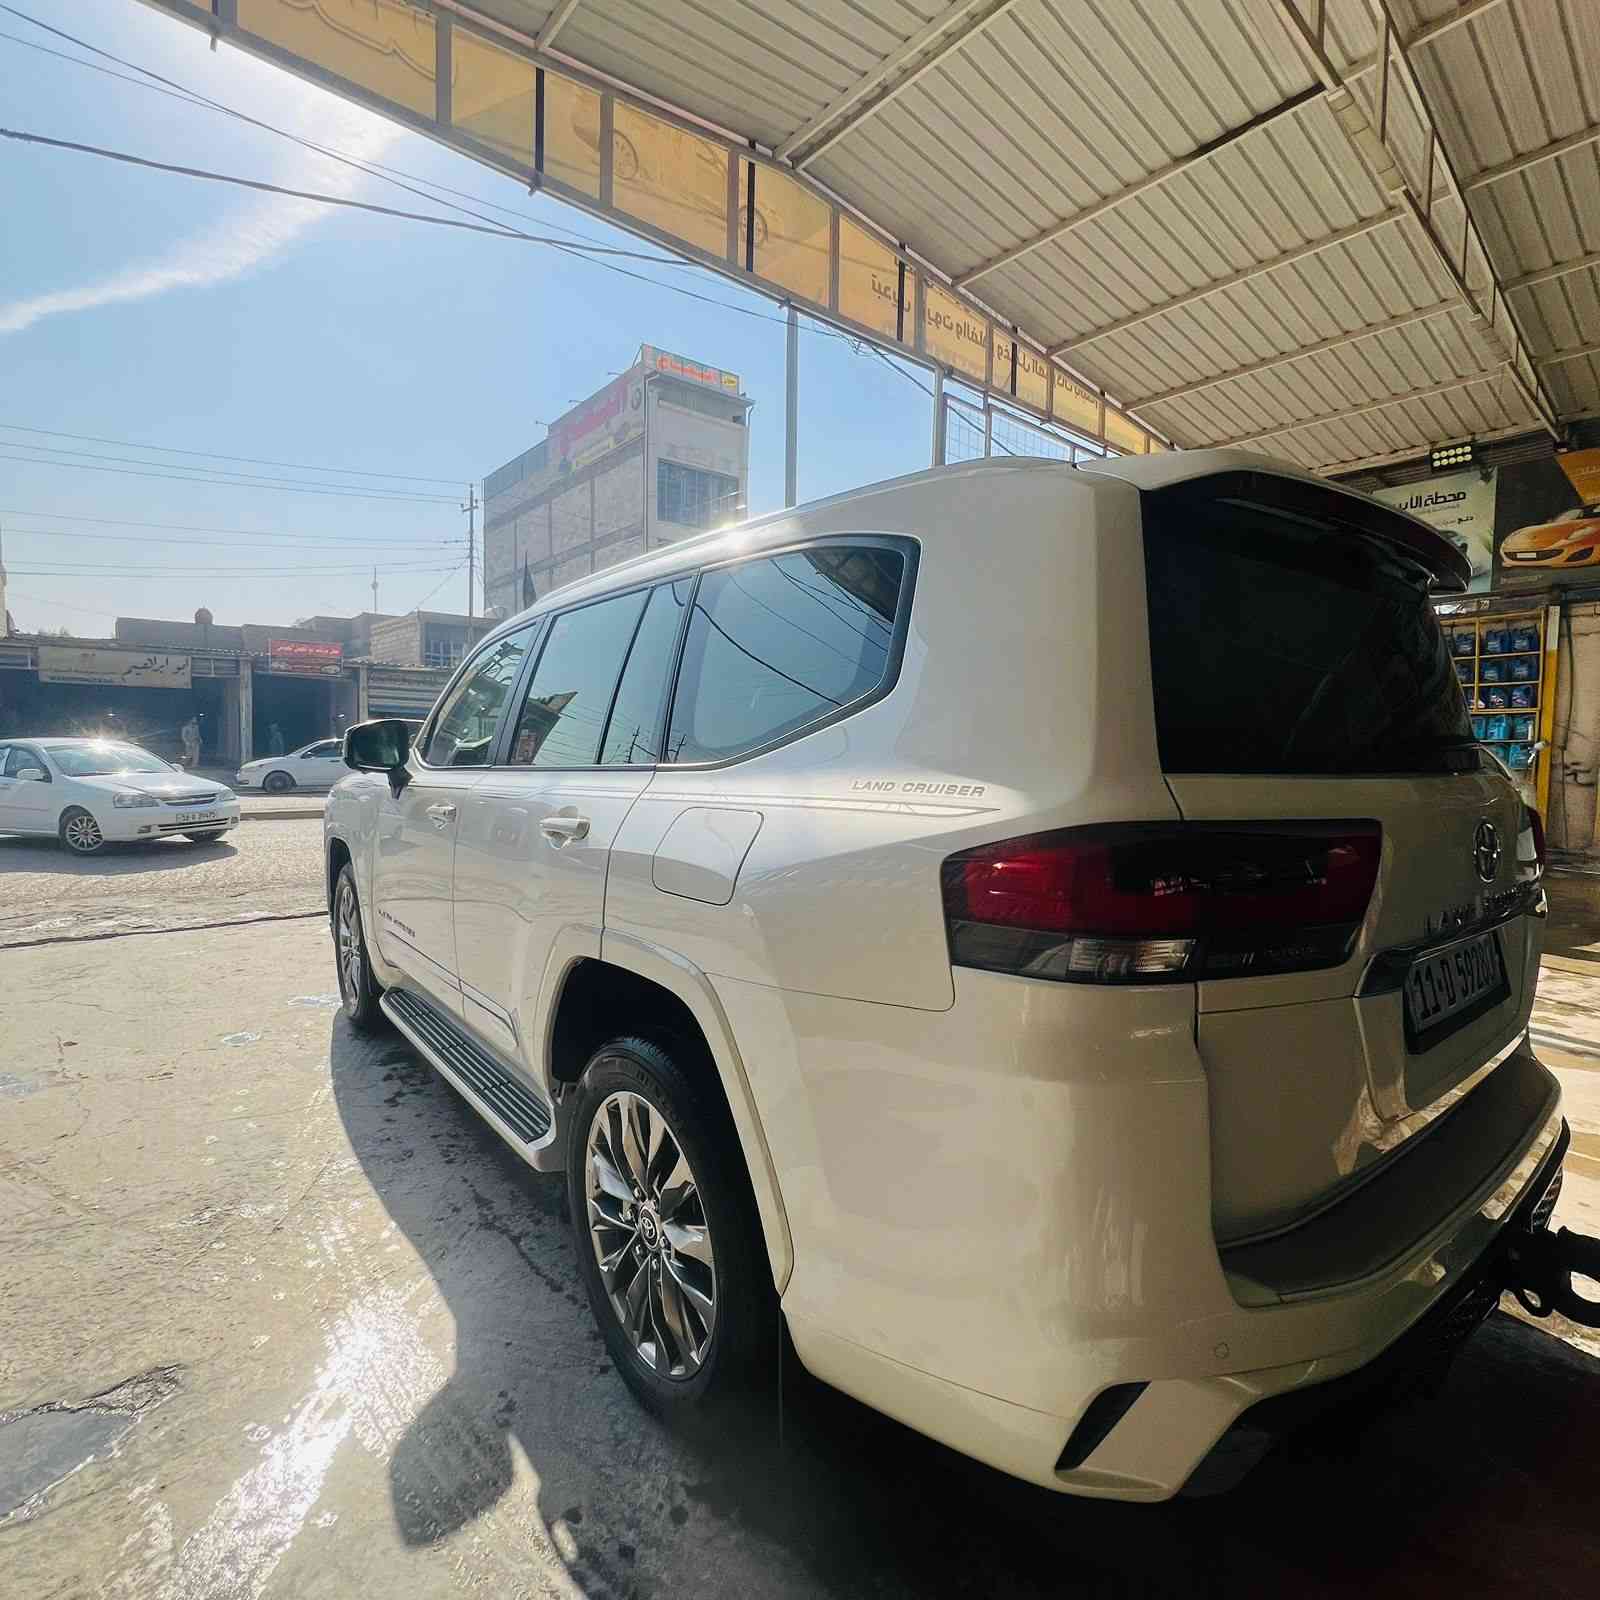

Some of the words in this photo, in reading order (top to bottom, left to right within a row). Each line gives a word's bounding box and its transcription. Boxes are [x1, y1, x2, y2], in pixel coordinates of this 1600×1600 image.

[1424, 491, 1466, 507] محطة
[851, 780, 896, 792] LAND
[901, 782, 985, 797] CRUISER
